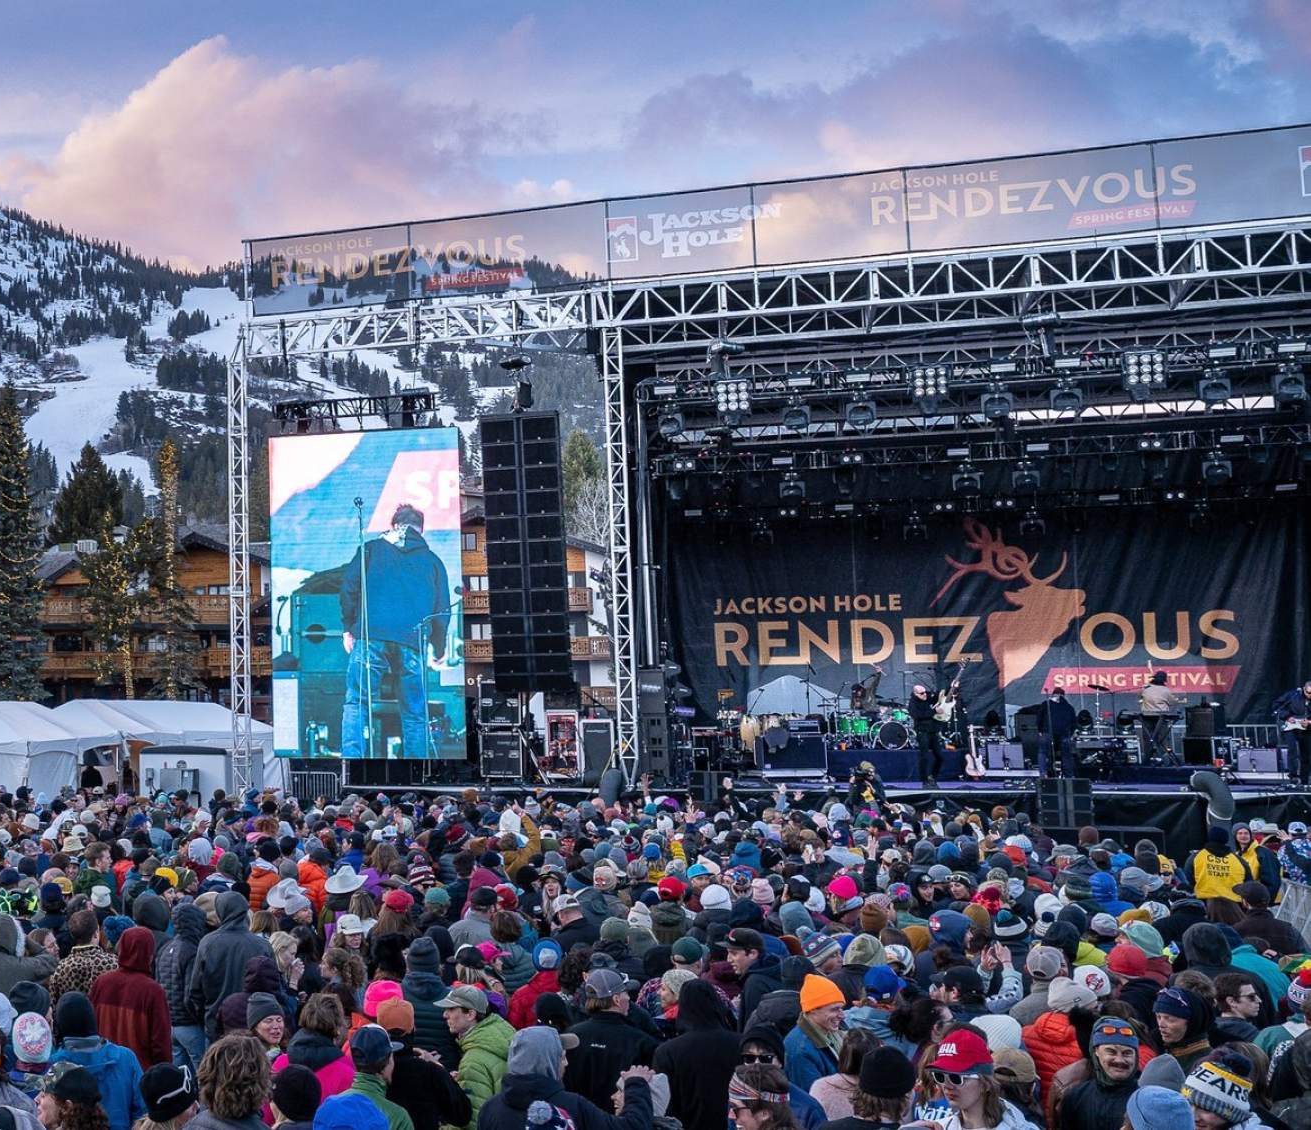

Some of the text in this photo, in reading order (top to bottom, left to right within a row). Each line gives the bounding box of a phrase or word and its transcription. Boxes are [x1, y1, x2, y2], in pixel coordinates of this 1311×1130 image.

[871, 170, 999, 193] JACKSON HOLE
[871, 164, 1197, 226] RENDEZVOUS
[638, 203, 782, 246] JACKSON
[1075, 205, 1188, 225] SPRING FESTIVAL
[271, 237, 373, 258] JACKSON HOLE
[661, 227, 743, 258] HOLE
[271, 234, 527, 288] RENDEZVOUS
[431, 271, 520, 286] SPRING FESTIVAL
[713, 594, 902, 616] JACKSON HOLE
[1053, 672, 1227, 688] SPRING FETIVAL
[1206, 855, 1229, 864] CSC
[1206, 864, 1230, 872] EVENT
[1189, 1065, 1250, 1103] BEARS
